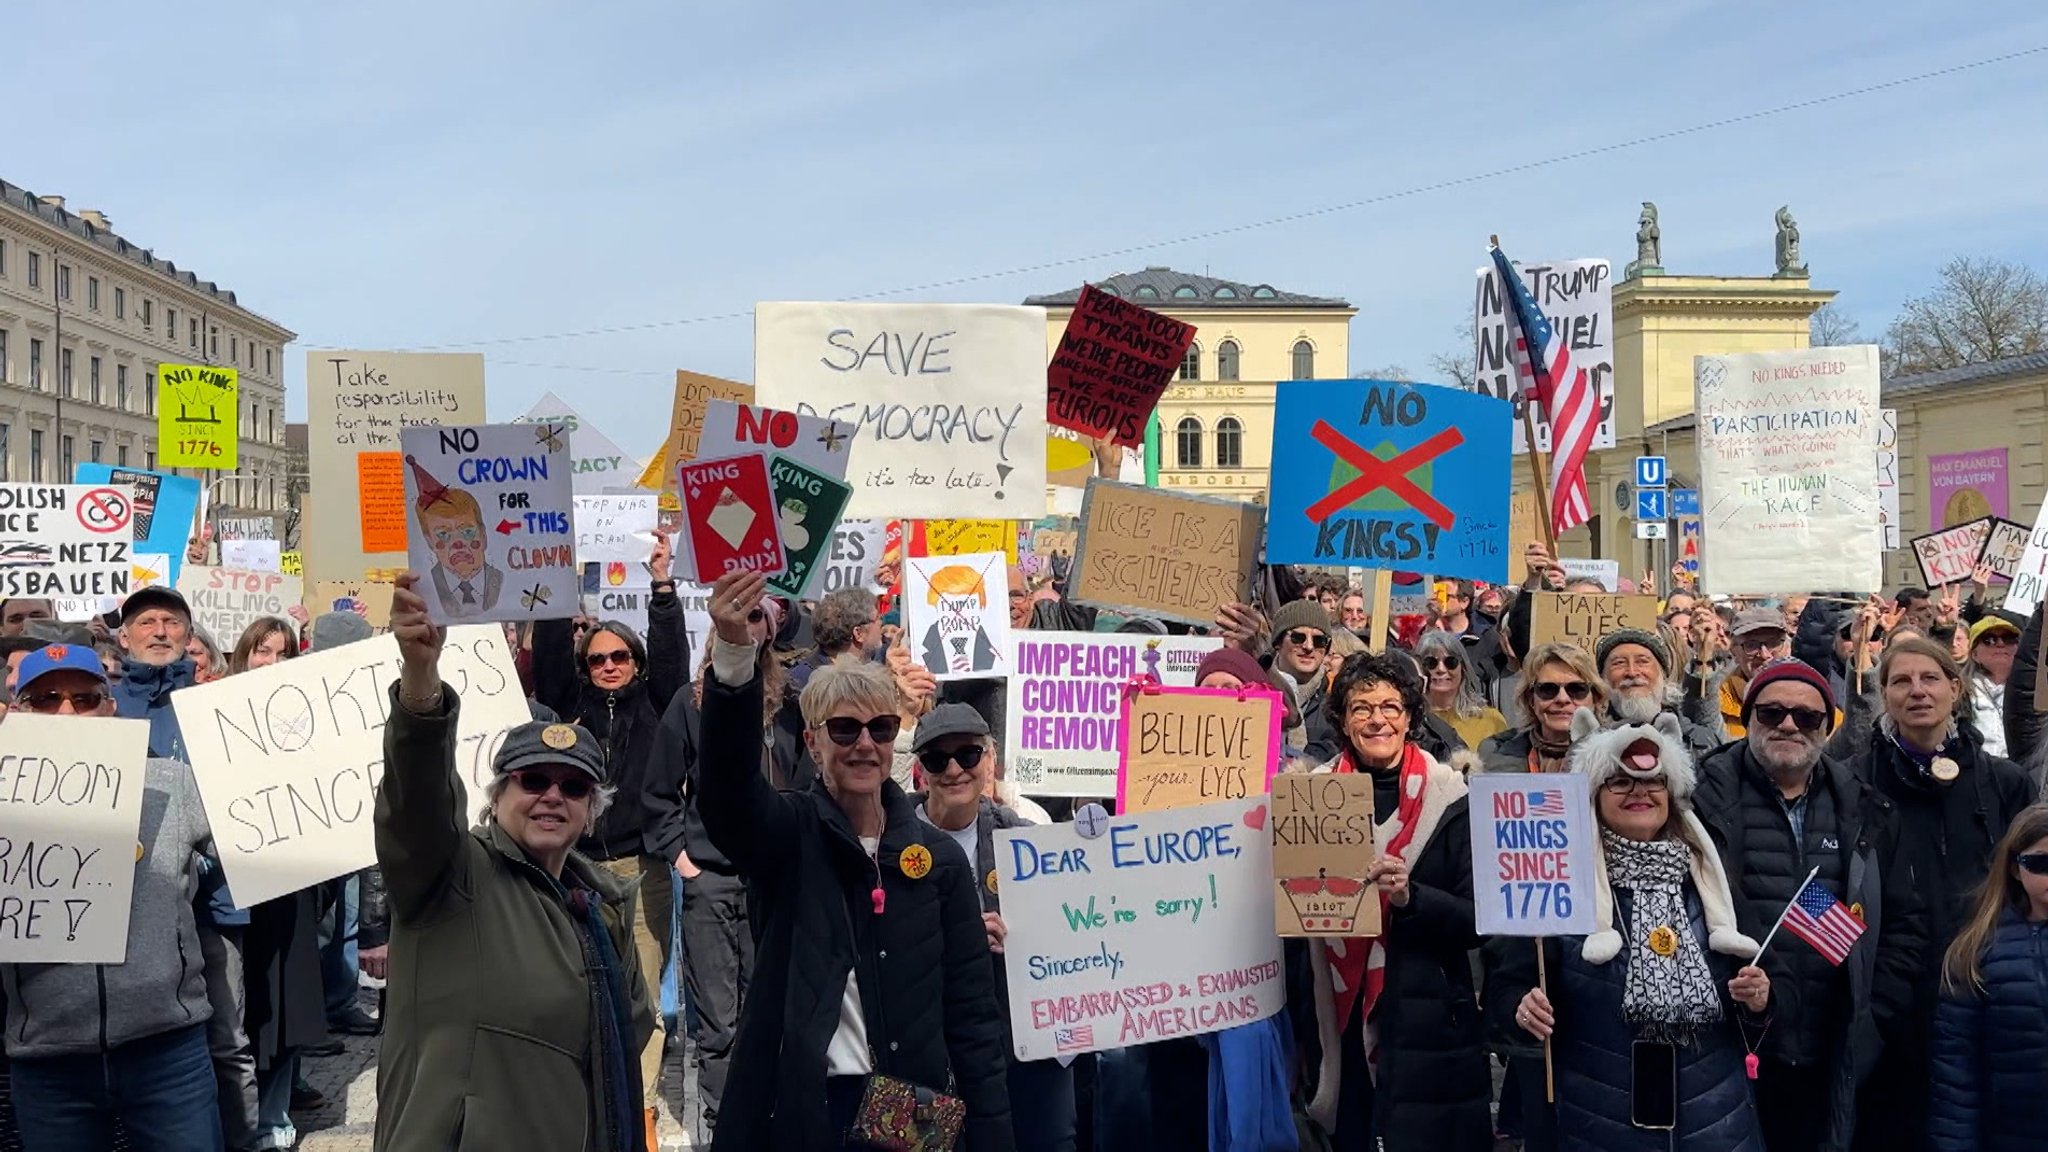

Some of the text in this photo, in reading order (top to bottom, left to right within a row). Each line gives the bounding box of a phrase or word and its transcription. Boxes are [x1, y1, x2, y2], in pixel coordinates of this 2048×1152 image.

[1082, 288, 1127, 322] FEAR
[1481, 264, 1610, 317] N TRUMP
[1081, 313, 1175, 361] TYRANTS
[1478, 324, 1513, 372] N
[820, 328, 957, 377] SAVE
[164, 368, 193, 386] NO
[328, 359, 389, 388] Take
[1752, 360, 1847, 384] NO KINGS NEEDED
[335, 388, 459, 412] responsibility
[1067, 374, 1141, 408] WE ARE
[335, 412, 361, 429] for
[1048, 386, 1140, 440] FURIOUS
[1360, 386, 1428, 428] NO
[736, 403, 799, 449] NO
[797, 402, 1023, 462] MOCRACY
[1712, 408, 1858, 436] PARTICIPATION
[177, 440, 222, 457] 1776
[439, 427, 480, 455] NO
[458, 454, 549, 486] CROWN
[906, 467, 935, 487] too
[1643, 463, 1658, 483] U
[1932, 456, 2003, 474] MAX EMANUEL
[1933, 471, 1997, 487] VON BAYERN
[686, 463, 740, 487] KING
[772, 463, 823, 497] KING
[1741, 473, 1828, 497] THE HUMAN
[499, 491, 531, 511] FOR
[1763, 494, 1824, 515] RACE
[523, 511, 570, 535] THIS
[596, 517, 614, 527] ON
[1097, 501, 1242, 559] ICE IS A
[59, 541, 128, 563] NETZ
[1313, 516, 1440, 561] KINGS!
[1459, 540, 1500, 559] 1776
[1942, 528, 1969, 551] NO
[507, 544, 573, 571] CLOWN
[1982, 552, 2021, 575] NOT
[208, 567, 284, 593] STOP
[191, 589, 283, 615] KILLING
[601, 592, 638, 611] CAN
[1018, 641, 1136, 679] IMPEACH
[213, 683, 316, 764] NO
[1140, 711, 1253, 761] BELIEVE
[1144, 765, 1247, 806] your EYES
[1493, 791, 1527, 819] NO
[1272, 813, 1375, 847] KINGS!
[1495, 820, 1569, 850] KINGS
[1498, 851, 1572, 882] SINCE
[1062, 873, 1218, 933] We're sorry!
[1500, 882, 1573, 920] 1776
[1028, 941, 1126, 981] Sincerely,
[1030, 959, 1281, 1031] EMBARRASSED & EXHAUSTED
[1118, 994, 1260, 1044] AMERICANS
